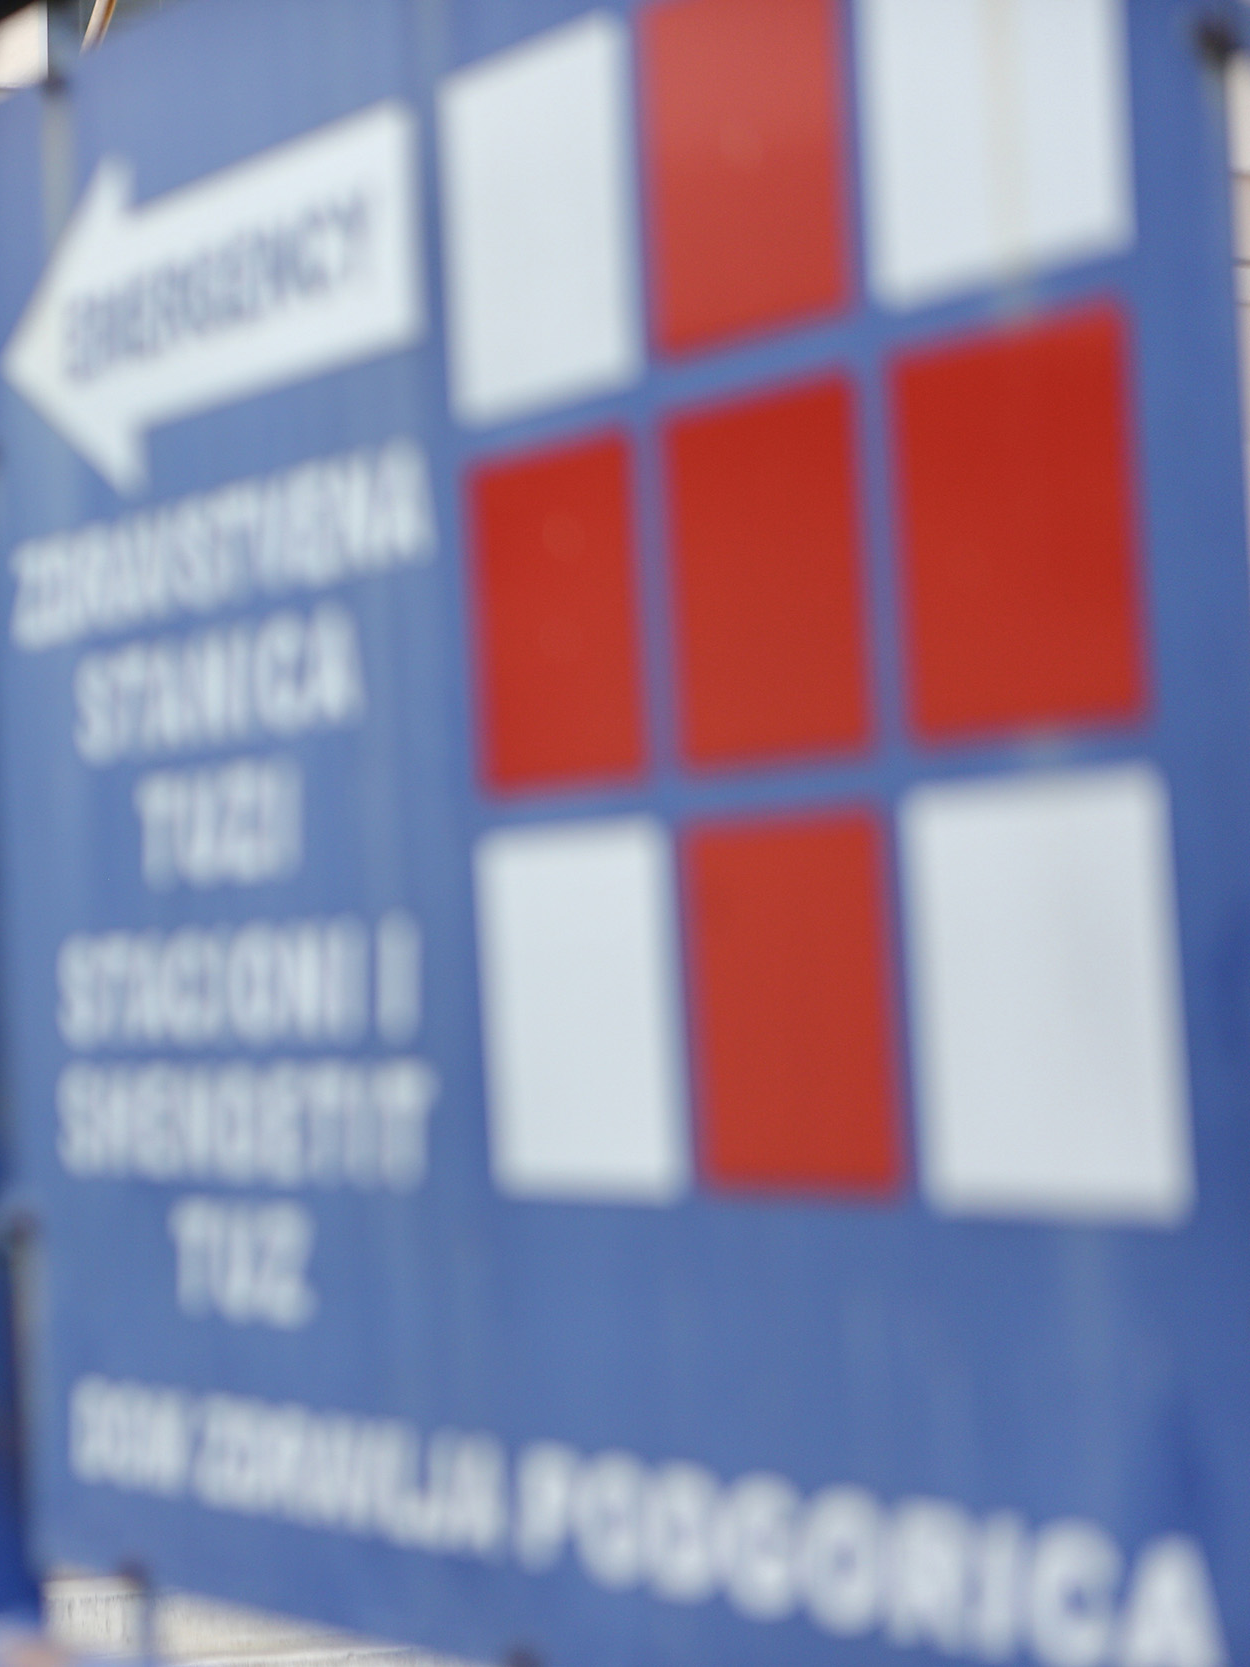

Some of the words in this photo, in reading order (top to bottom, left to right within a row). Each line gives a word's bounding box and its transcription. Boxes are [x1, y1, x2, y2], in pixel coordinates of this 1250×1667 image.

[67, 186, 368, 382] EMERGENCY
[80, 605, 356, 761] STANICA
[141, 761, 296, 882] TUZI
[177, 1203, 309, 1323] TUZ
[77, 1381, 182, 1489] DOM
[201, 1401, 500, 1559] ZDRAVLJA
[521, 1445, 1218, 1667] PODGORICA
